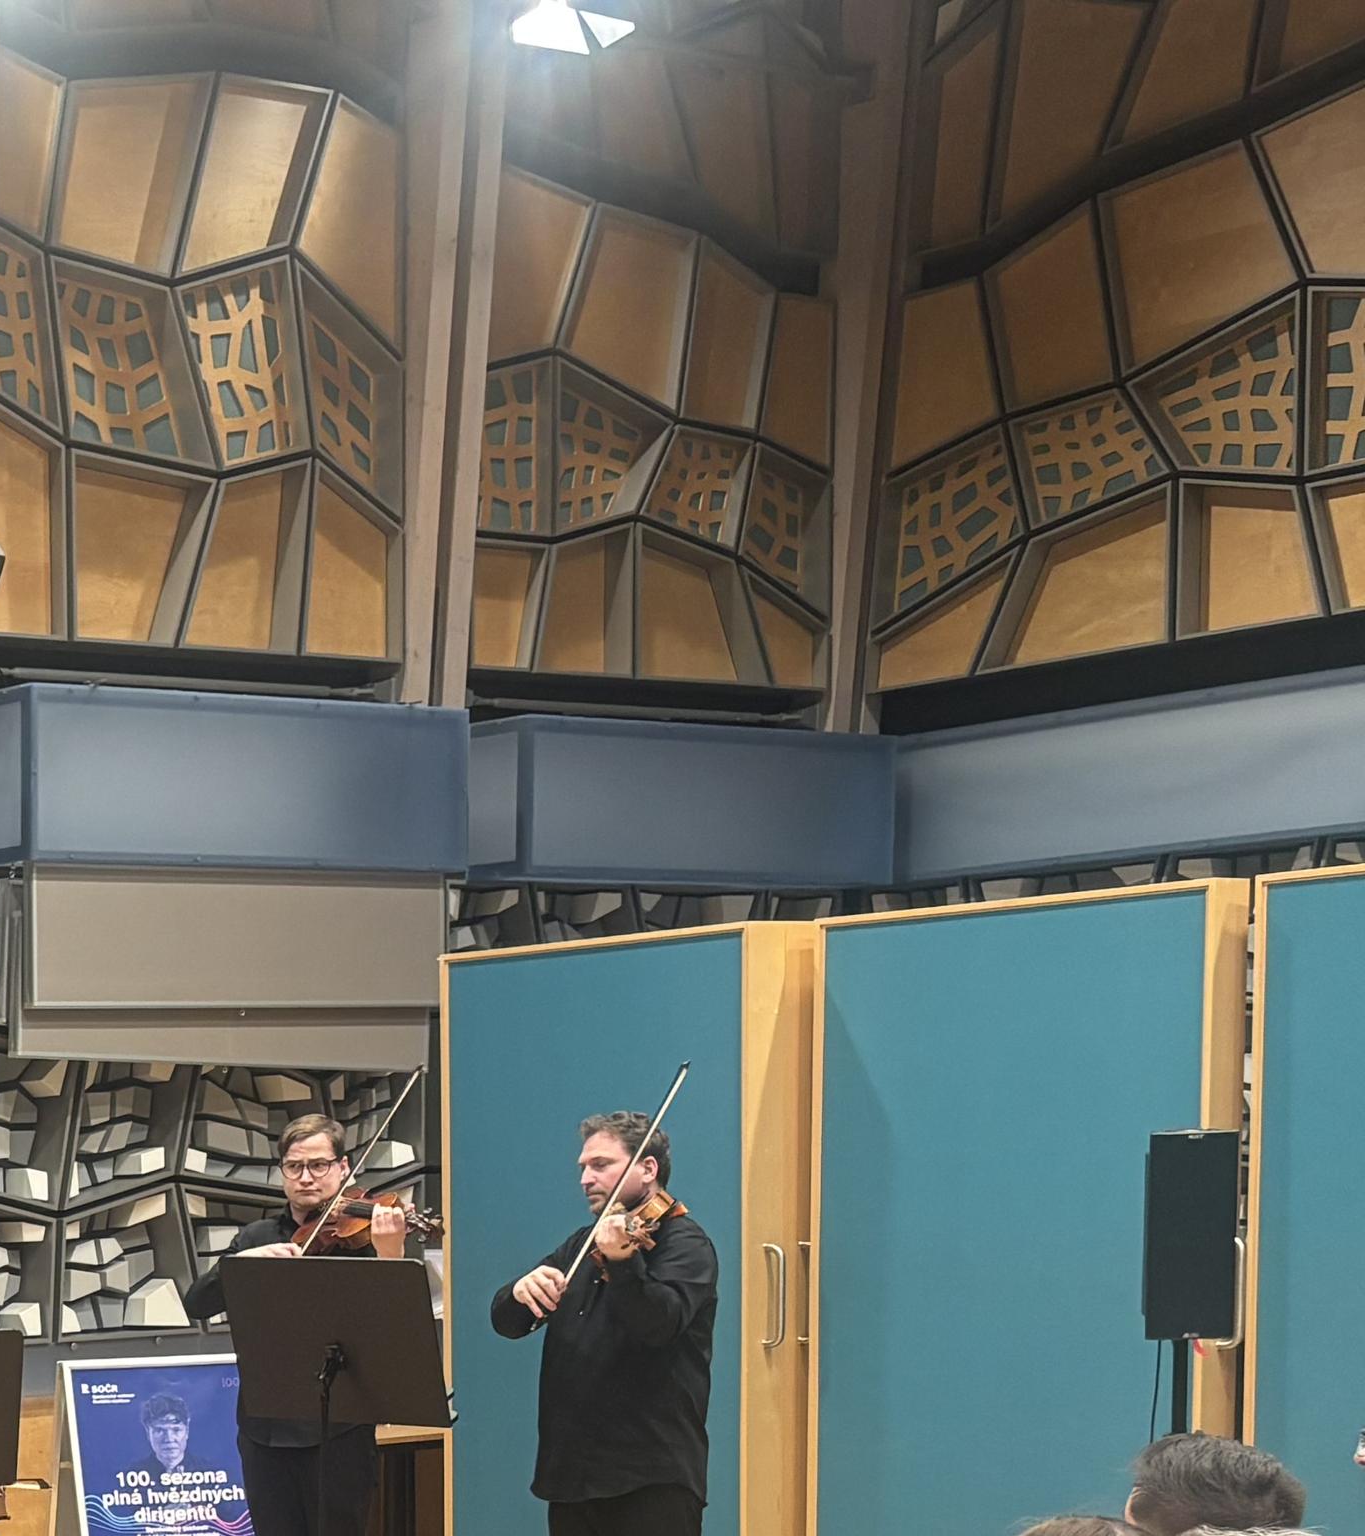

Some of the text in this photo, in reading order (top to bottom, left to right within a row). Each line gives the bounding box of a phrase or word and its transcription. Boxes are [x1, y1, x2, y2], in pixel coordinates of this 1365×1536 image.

[116, 1470, 227, 1487] 100. sezona
[102, 1484, 245, 1508] plná hvězdných
[134, 1503, 217, 1525] dirigentů
